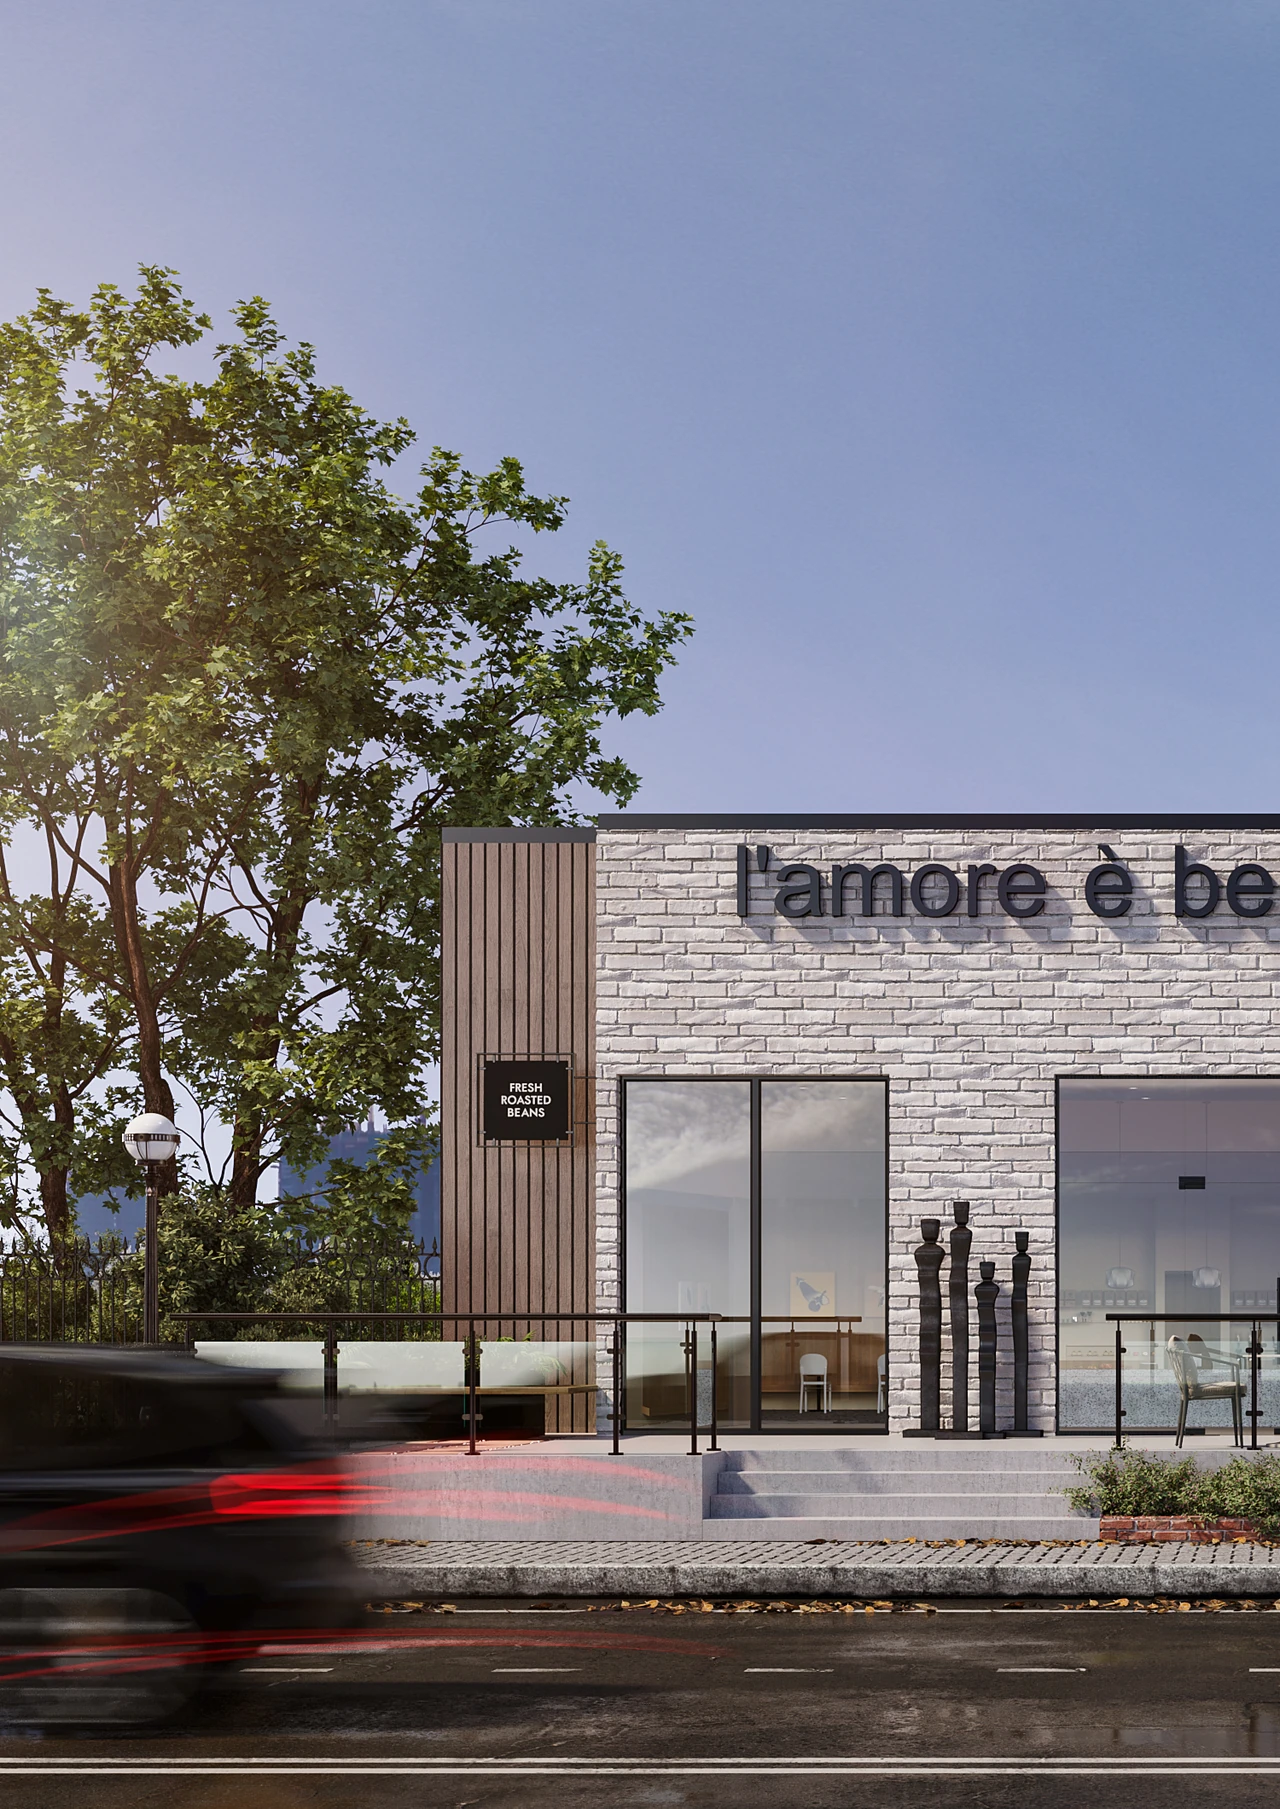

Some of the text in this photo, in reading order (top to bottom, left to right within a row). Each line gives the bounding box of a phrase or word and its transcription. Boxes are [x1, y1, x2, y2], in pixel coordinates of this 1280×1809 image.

[735, 844, 1047, 918] l'amore
[1084, 844, 1134, 918] è
[509, 1082, 543, 1093] FRESH
[500, 1094, 552, 1105] ROASTED
[507, 1107, 546, 1118] BEANS
